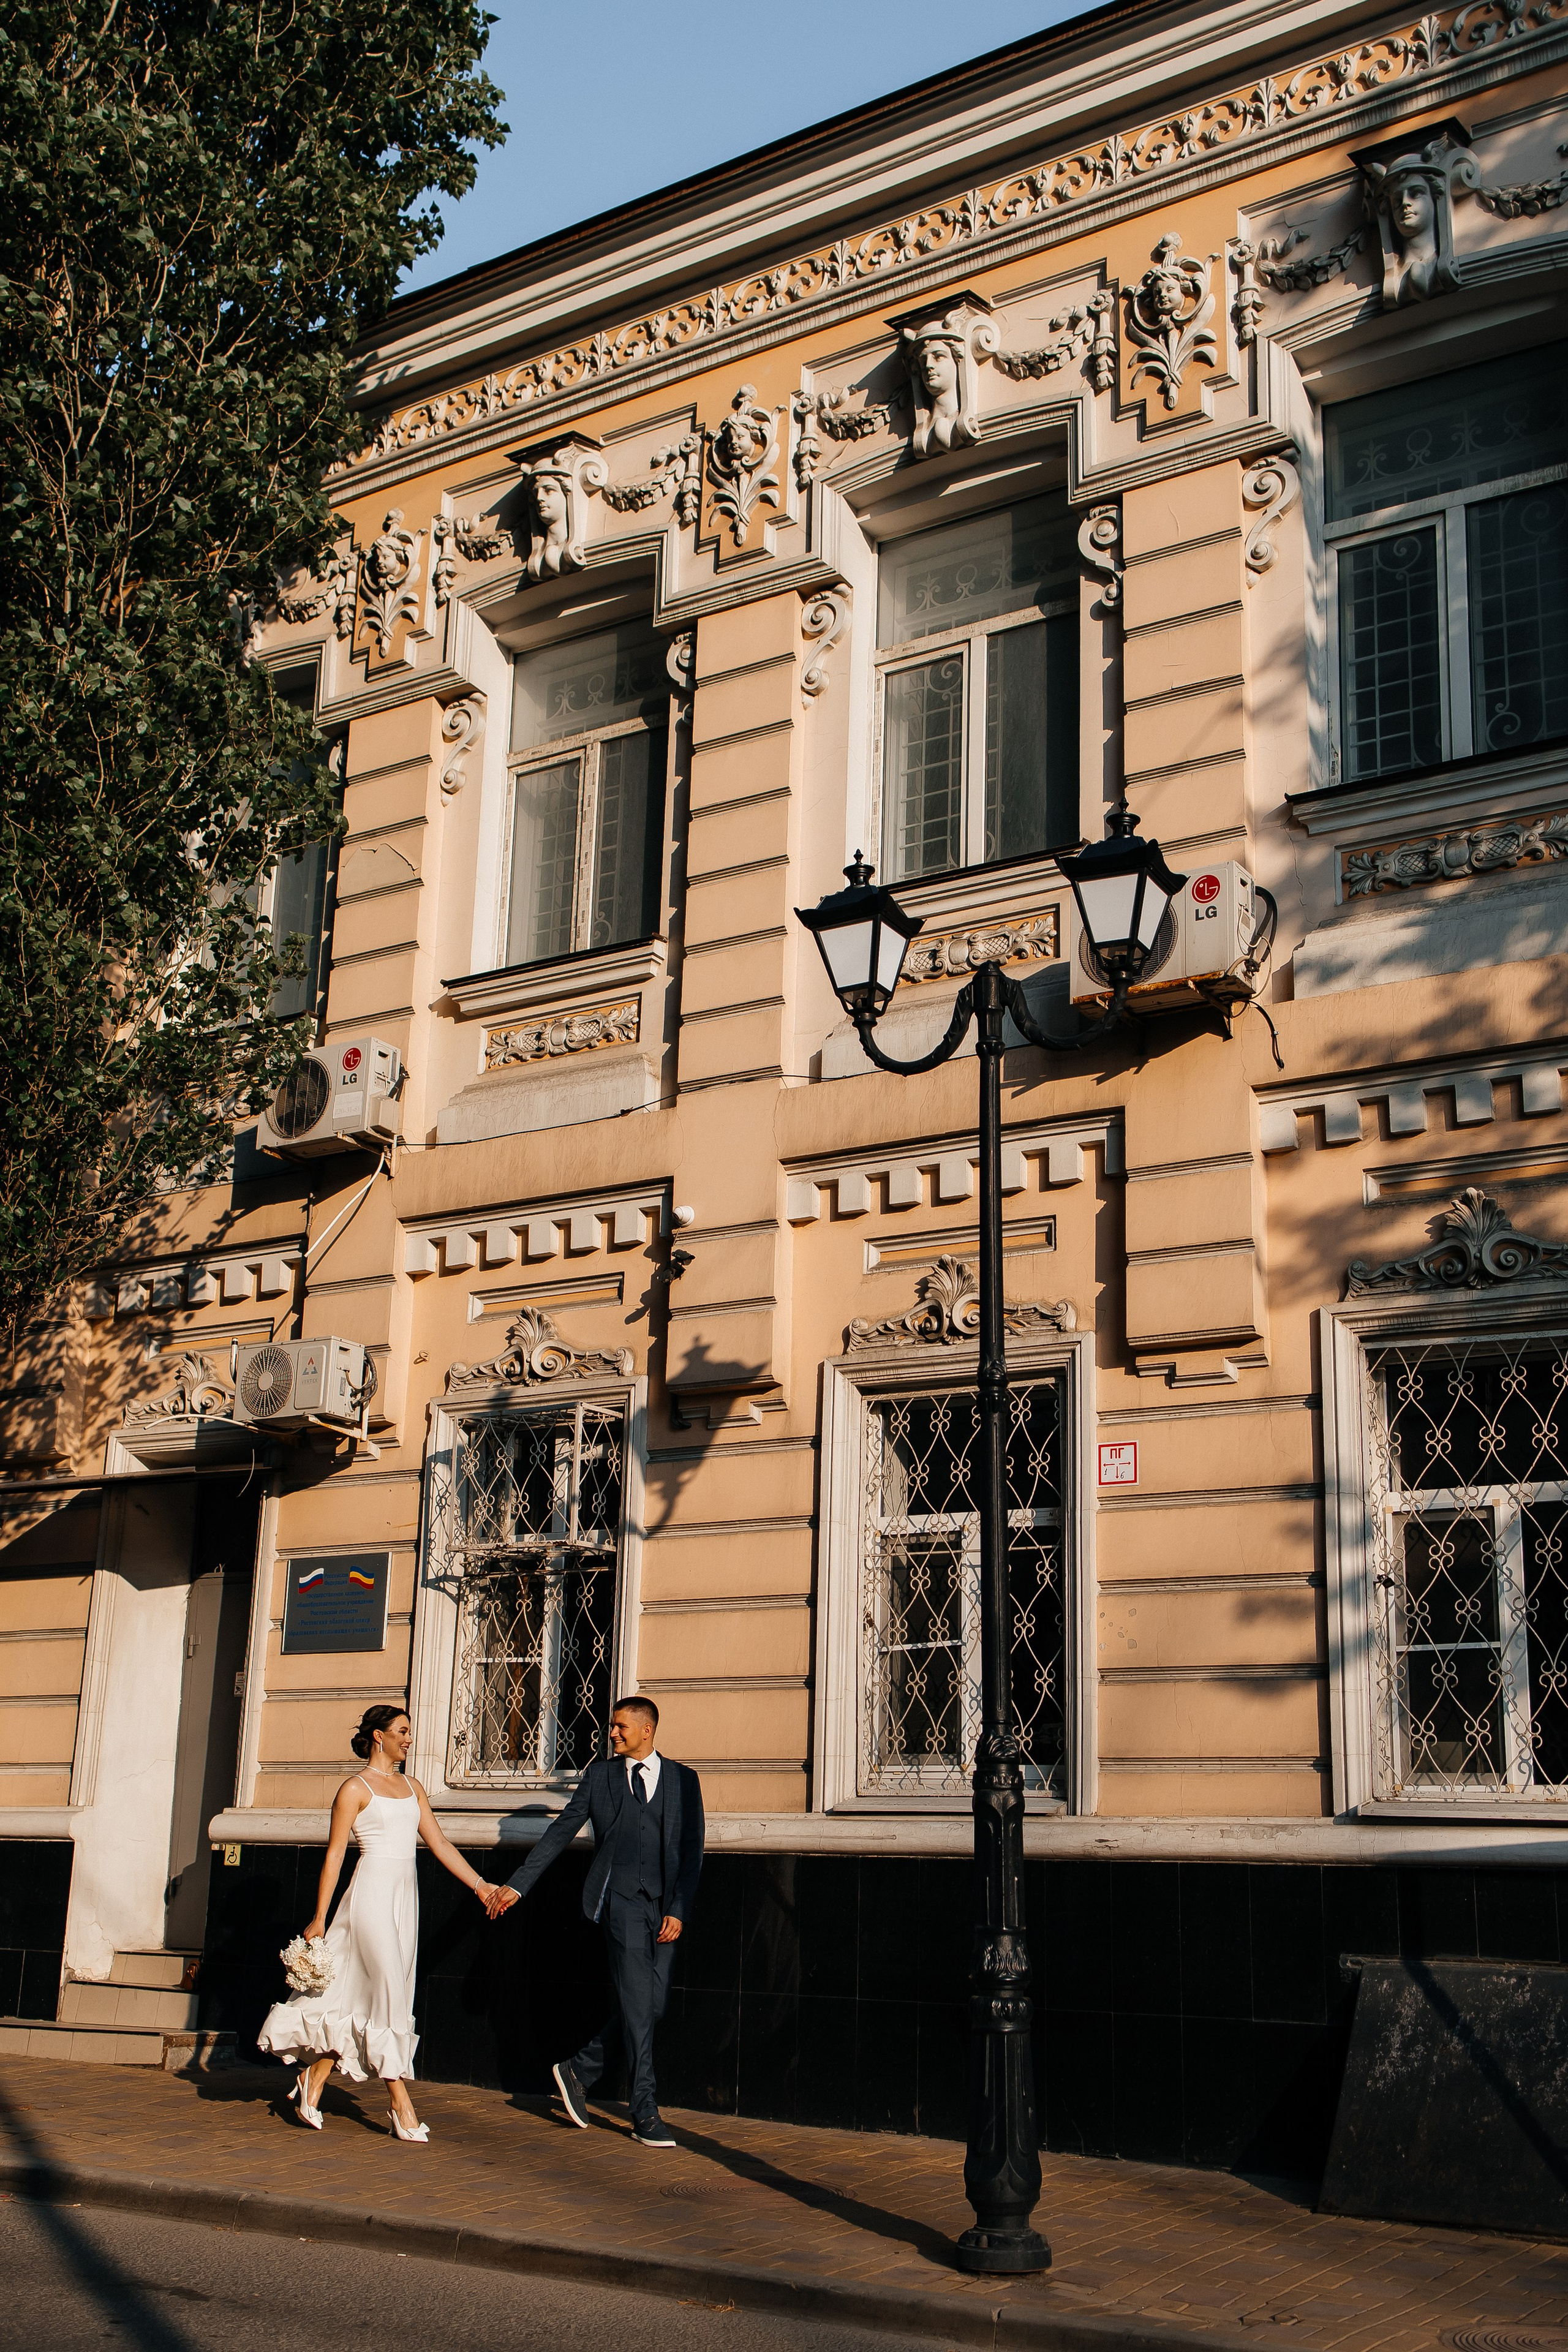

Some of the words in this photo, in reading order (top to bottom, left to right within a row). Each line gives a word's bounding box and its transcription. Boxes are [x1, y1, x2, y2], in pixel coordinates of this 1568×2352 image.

[1195, 905, 1218, 922] LG
[342, 1072, 358, 1086] LG
[1110, 1447, 1124, 1459] ПГ
